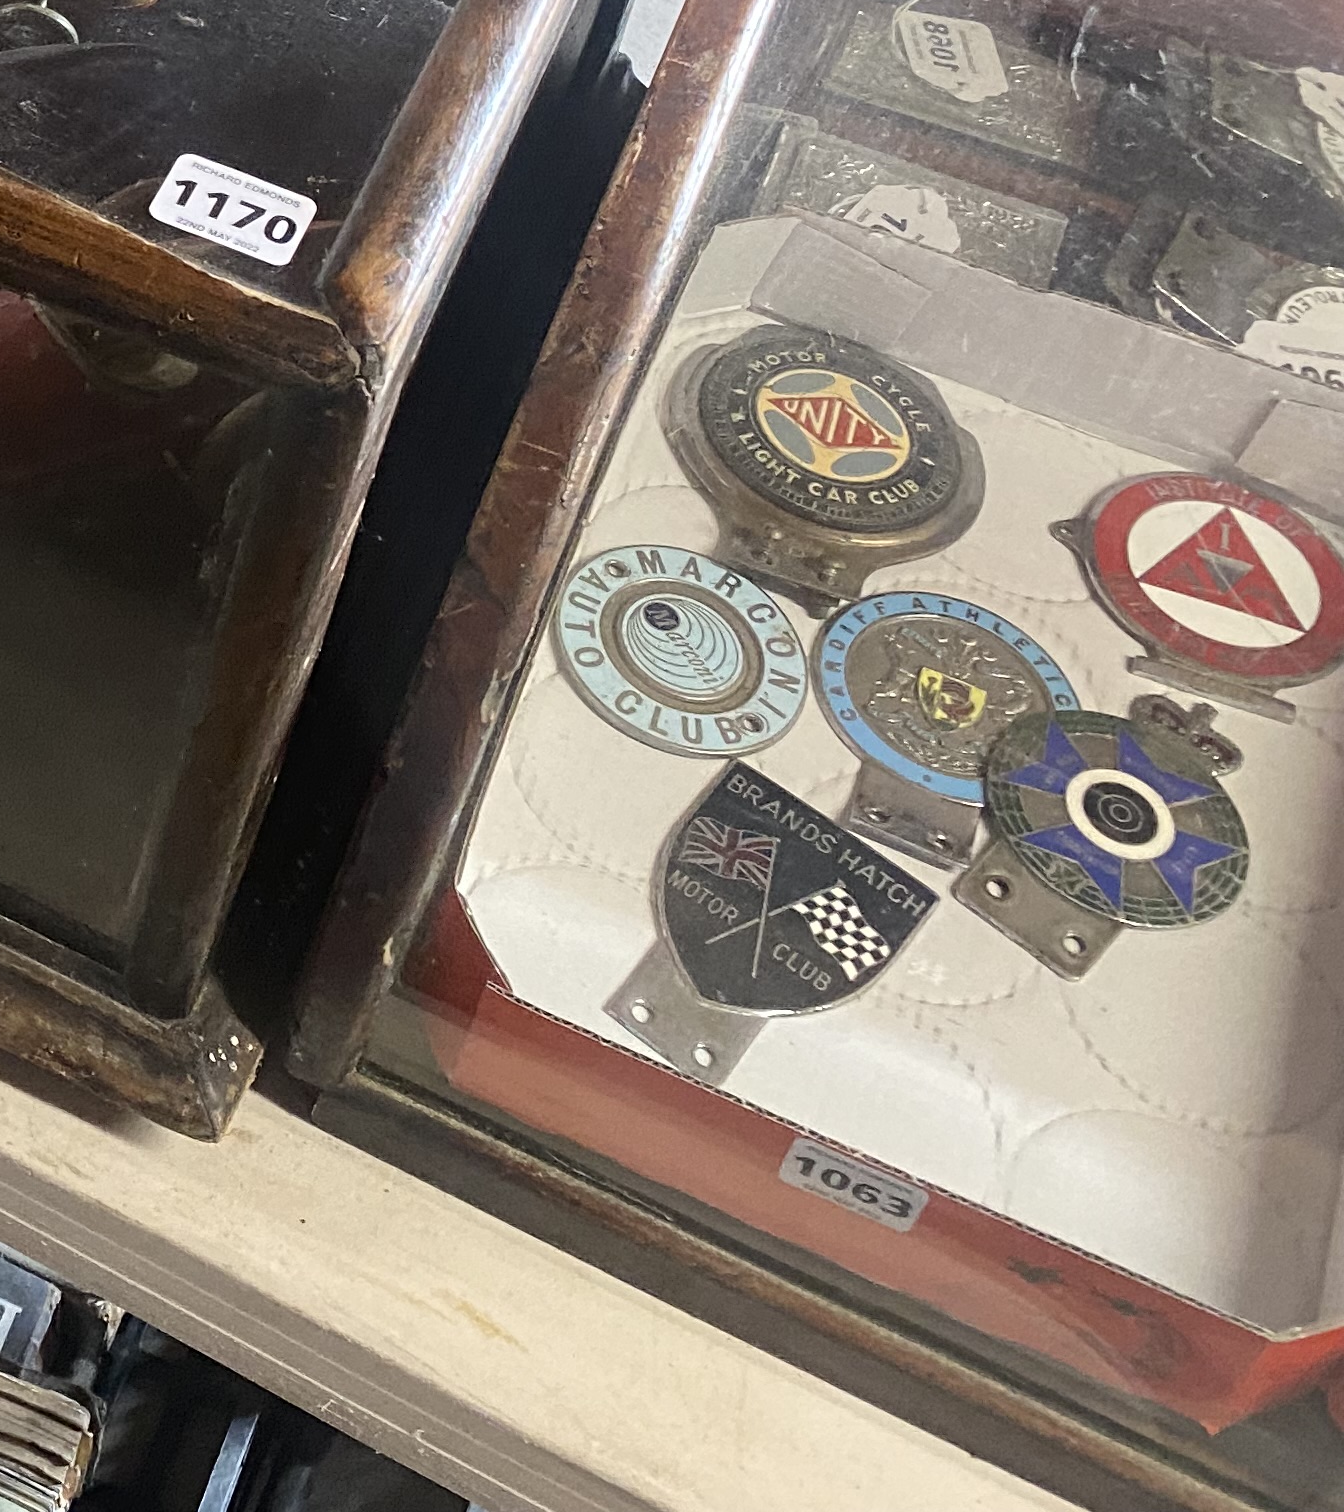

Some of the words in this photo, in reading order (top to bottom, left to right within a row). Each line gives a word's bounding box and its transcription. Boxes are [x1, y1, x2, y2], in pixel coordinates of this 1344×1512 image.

[175, 180, 298, 244] 1170
[192, 162, 242, 186] RICHARD
[244, 182, 301, 208] EDMONDS
[175, 216, 206, 233] 22ND
[208, 226, 233, 242] MAY
[750, 351, 827, 375] MOTOR
[871, 374, 933, 434] CYCLE
[782, 397, 890, 447] UNITY
[738, 431, 802, 485] LIGHT
[808, 481, 858, 506] CAR
[867, 478, 921, 506] CLUB
[564, 567, 611, 668] AUTO
[635, 549, 801, 720] MARCONI
[643, 601, 725, 685] Marconi
[823, 600, 887, 722] CARDIFF
[911, 596, 1073, 708] ATHLETIC
[614, 689, 742, 745] CLUB
[725, 773, 839, 855] BRANDS
[838, 848, 927, 918] HATCH
[667, 869, 741, 926] MOTOR
[772, 942, 833, 992] CLUB
[793, 1154, 914, 1219] 1063
